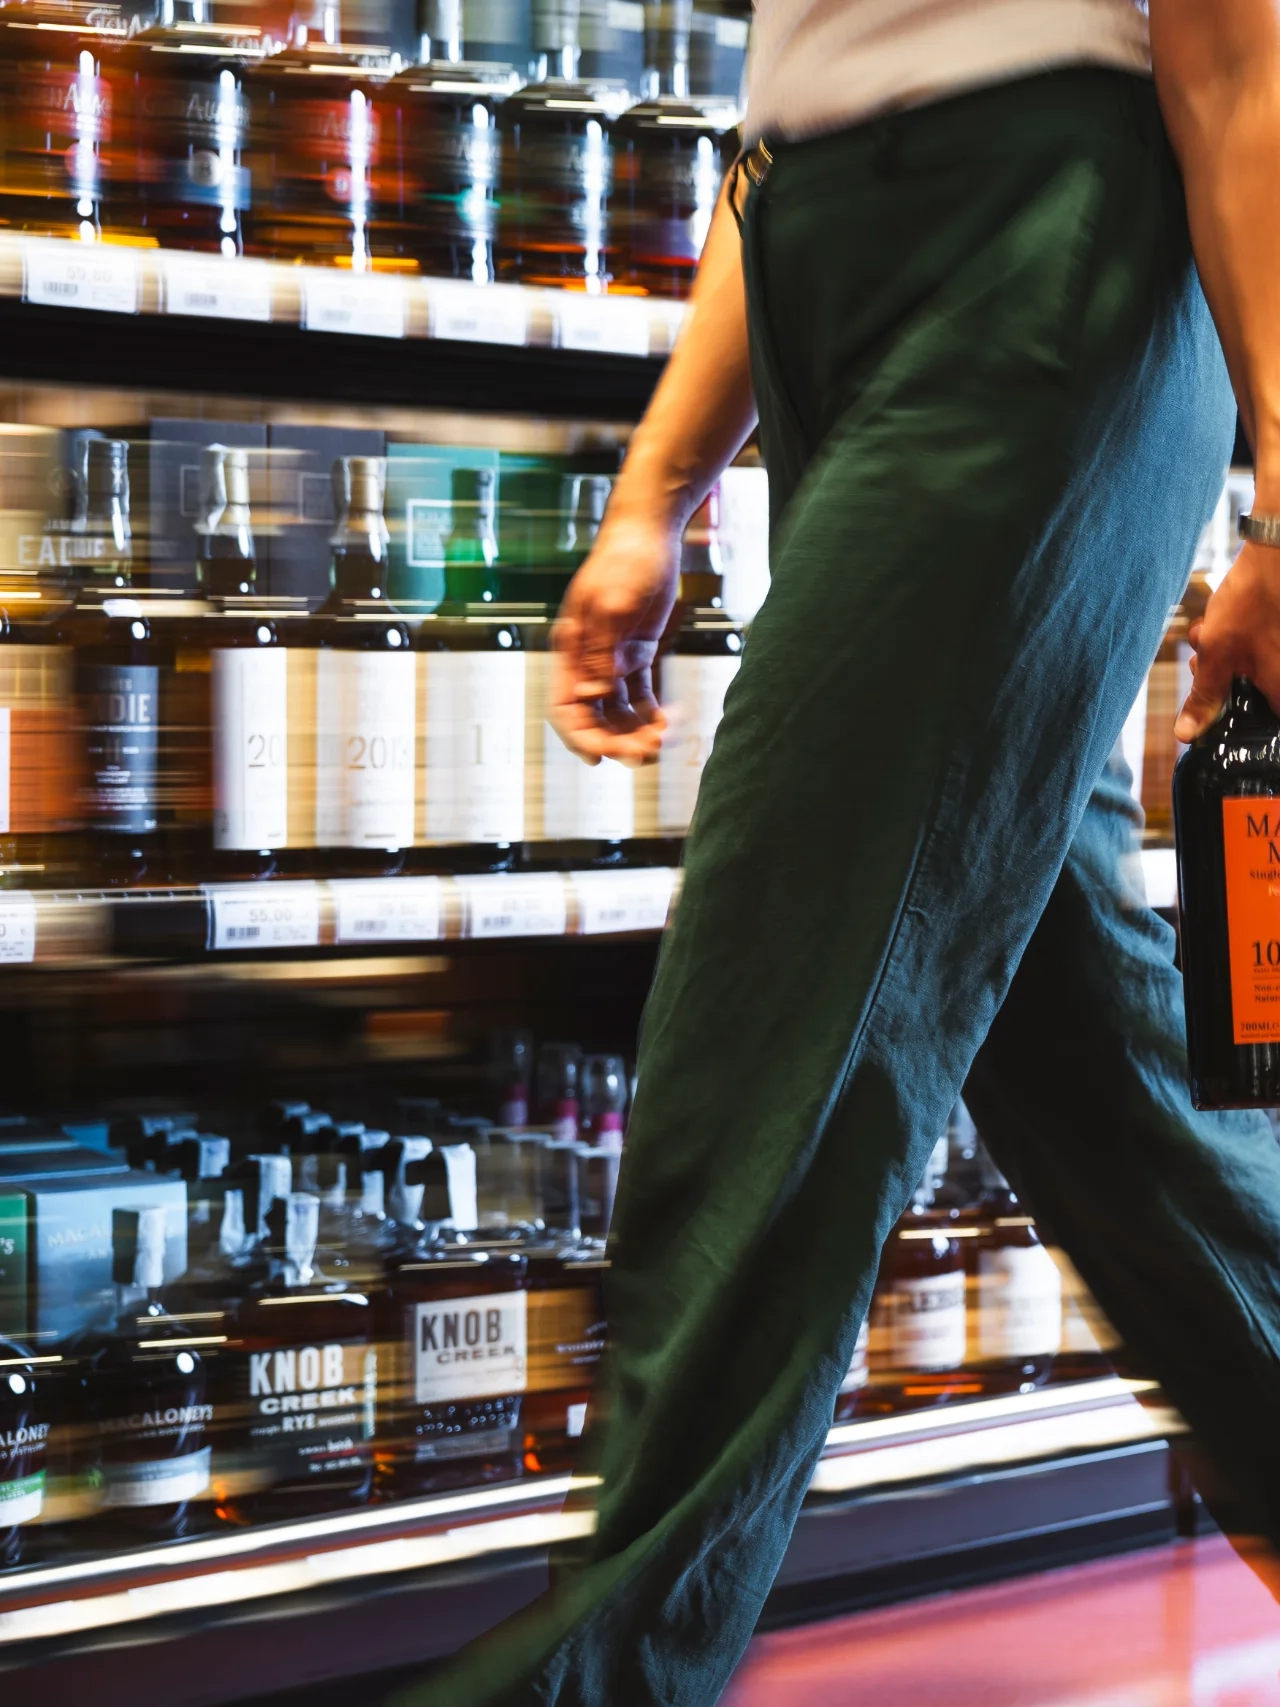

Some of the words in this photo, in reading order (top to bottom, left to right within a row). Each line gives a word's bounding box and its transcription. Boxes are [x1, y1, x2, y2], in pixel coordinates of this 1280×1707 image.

[421, 1309, 502, 1351] KNOB
[437, 1346, 516, 1364] CREEK
[250, 1344, 344, 1396] KNOB
[258, 1387, 356, 1415] CREEK
[282, 1413, 315, 1432] RYE
